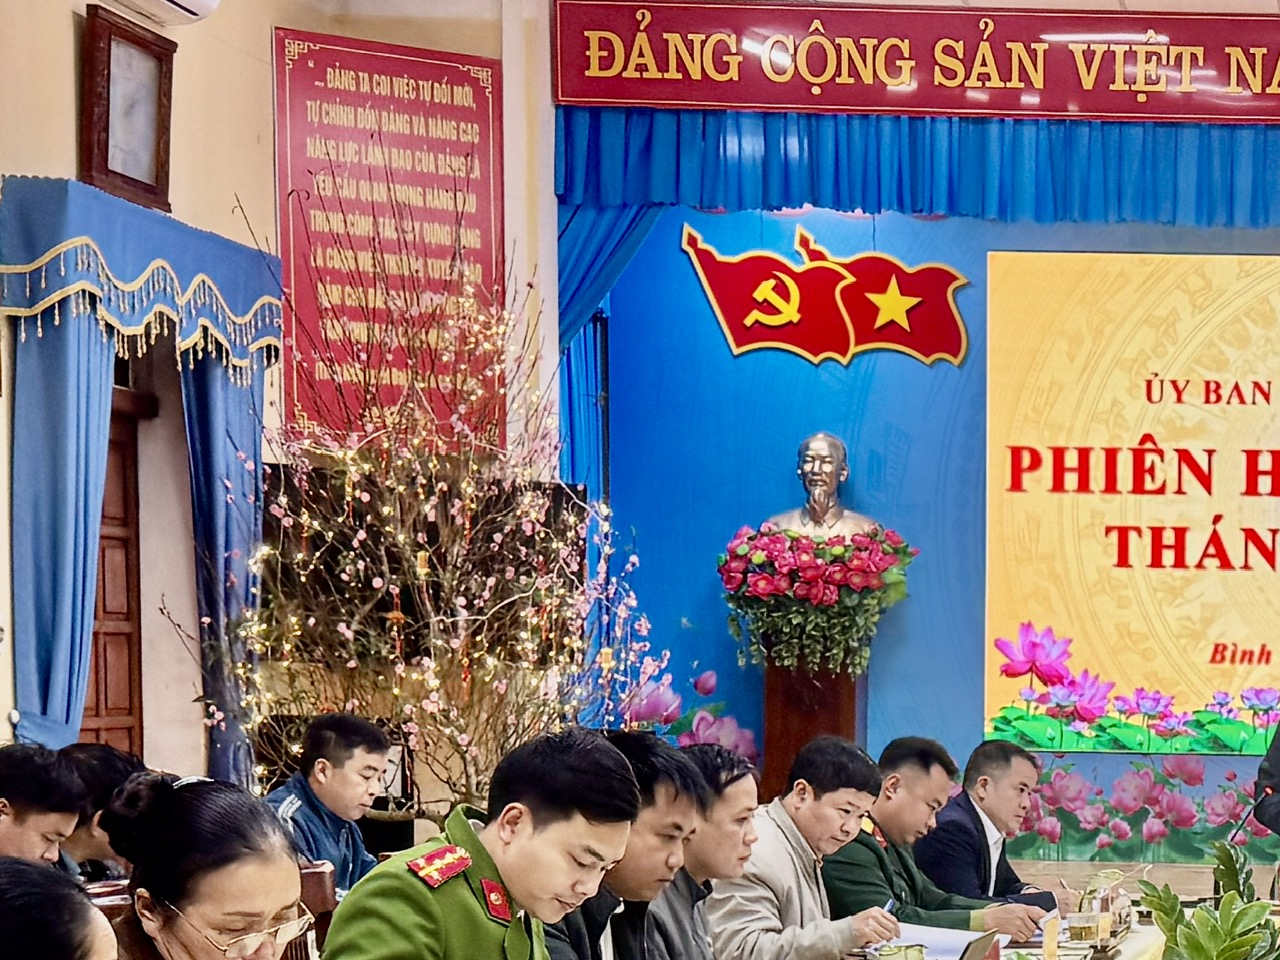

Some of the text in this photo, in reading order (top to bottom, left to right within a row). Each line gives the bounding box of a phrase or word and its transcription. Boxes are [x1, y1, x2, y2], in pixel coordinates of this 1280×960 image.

[584, 9, 743, 82] ĐẢNG
[760, 19, 916, 95] CỘNG
[933, 18, 1049, 90] SẢN
[1068, 29, 1204, 103] VIỆT
[1144, 372, 1191, 404] ỦY
[1203, 380, 1272, 406] BAN
[1005, 433, 1217, 496] PHIÊN
[1209, 643, 1272, 666] Bình
